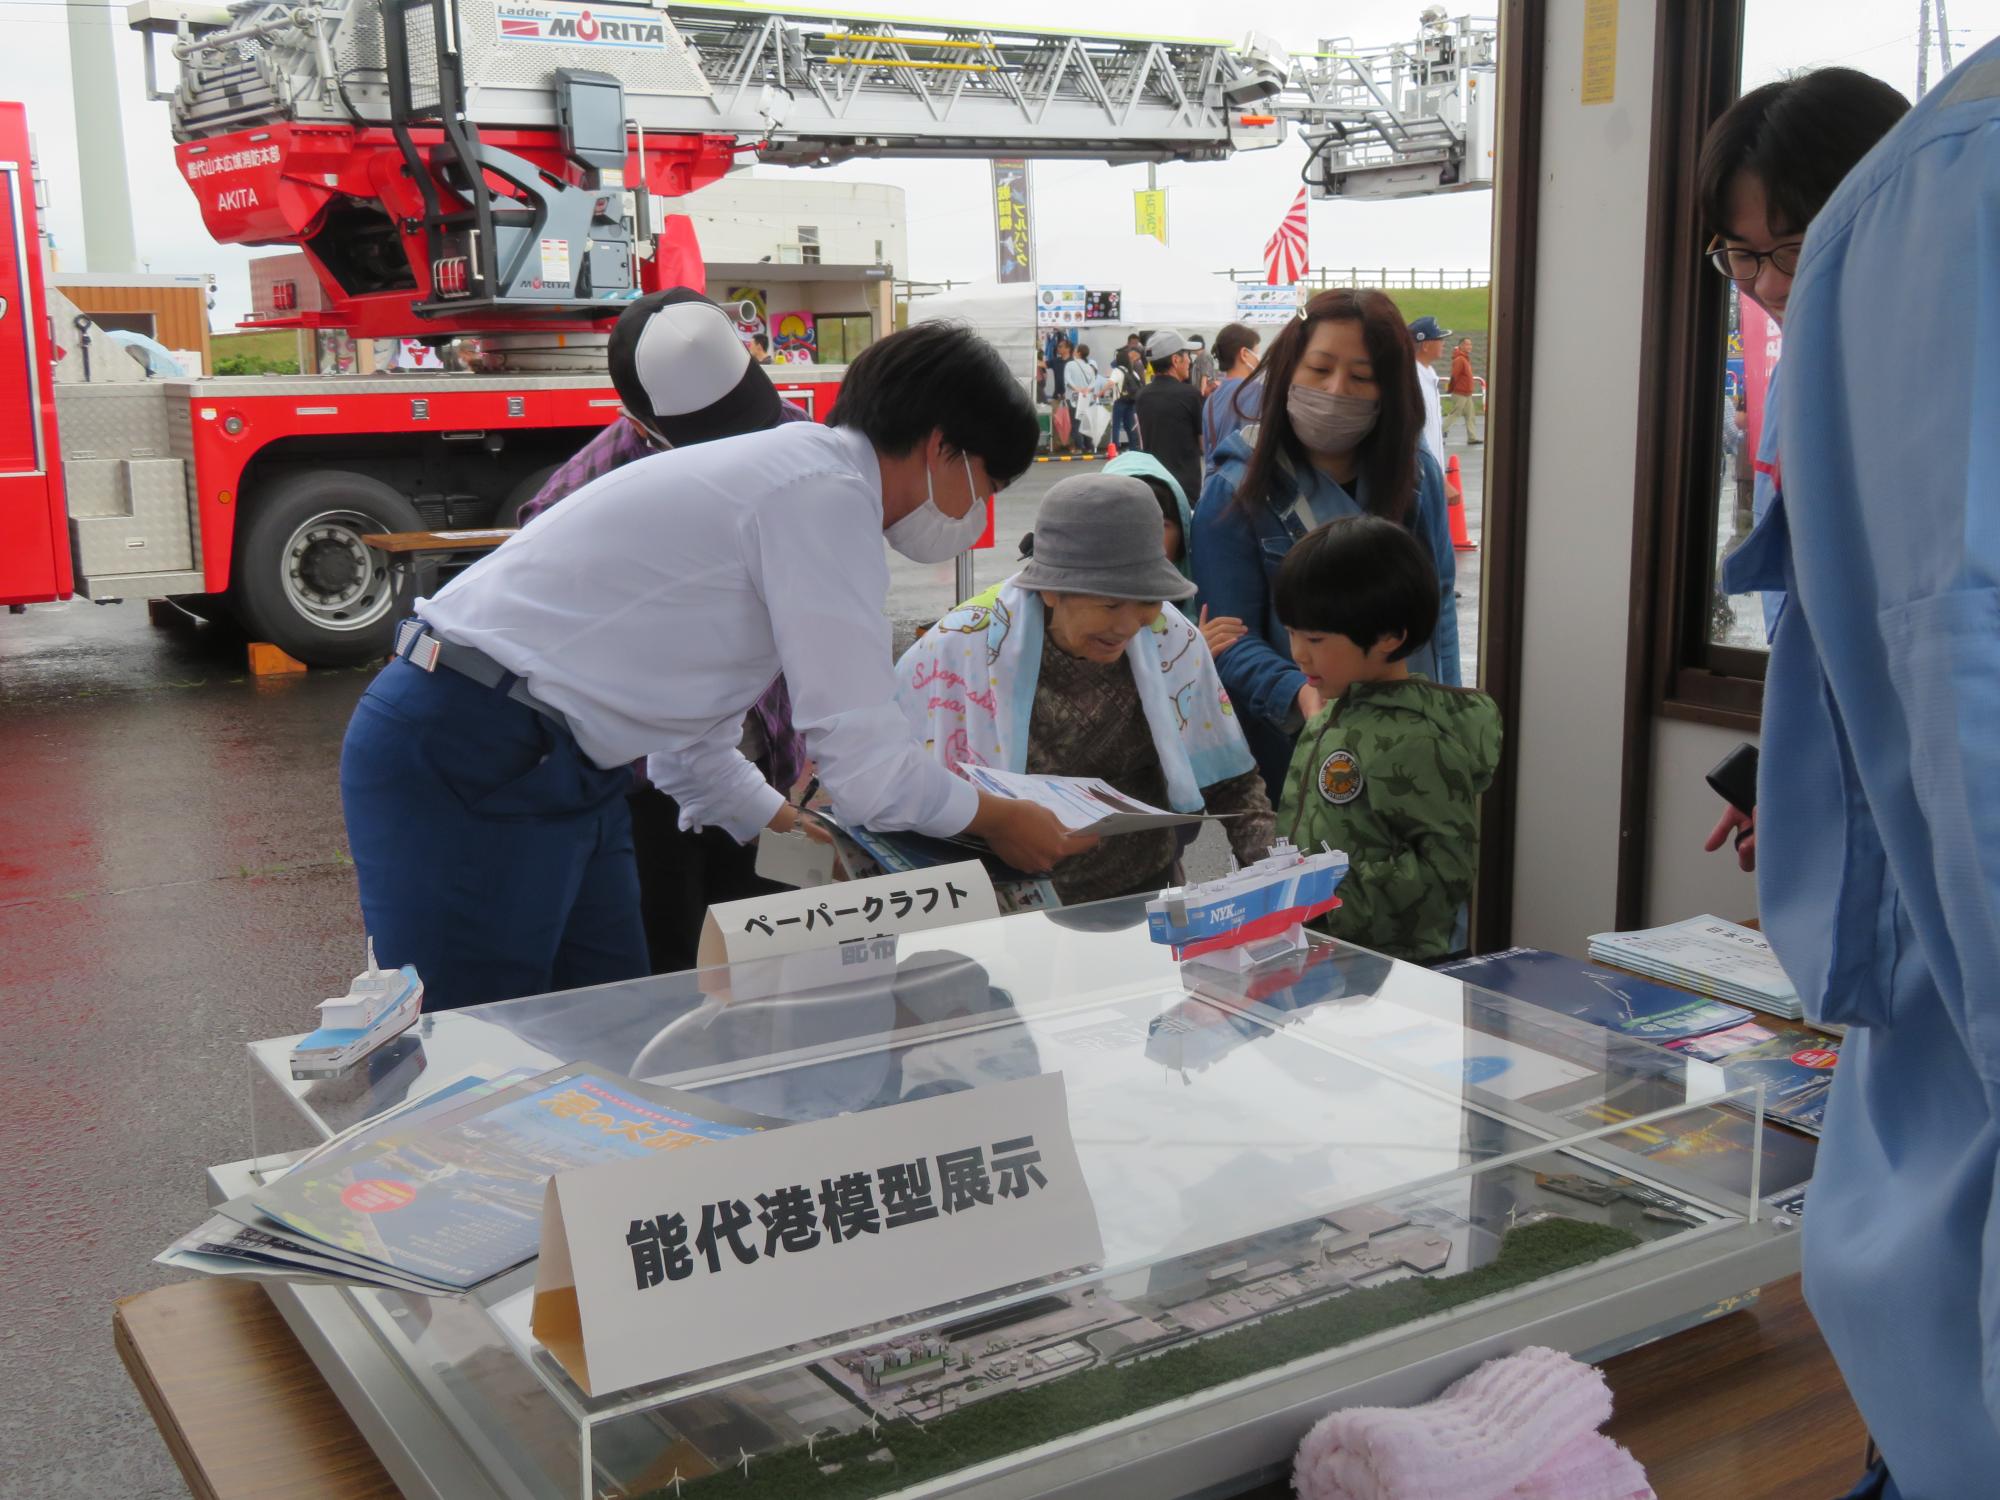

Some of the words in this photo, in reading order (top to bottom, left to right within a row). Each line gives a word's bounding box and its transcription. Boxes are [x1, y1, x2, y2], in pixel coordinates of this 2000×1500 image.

[498, 6, 551, 18] Ladder
[549, 10, 664, 42] MORITA
[218, 188, 259, 212] AKITA
[520, 277, 570, 290] MORITA
[744, 881, 968, 937] ペーパークラフト
[1210, 903, 1235, 924] NYK
[626, 1135, 1048, 1290] 能代港模型展示
